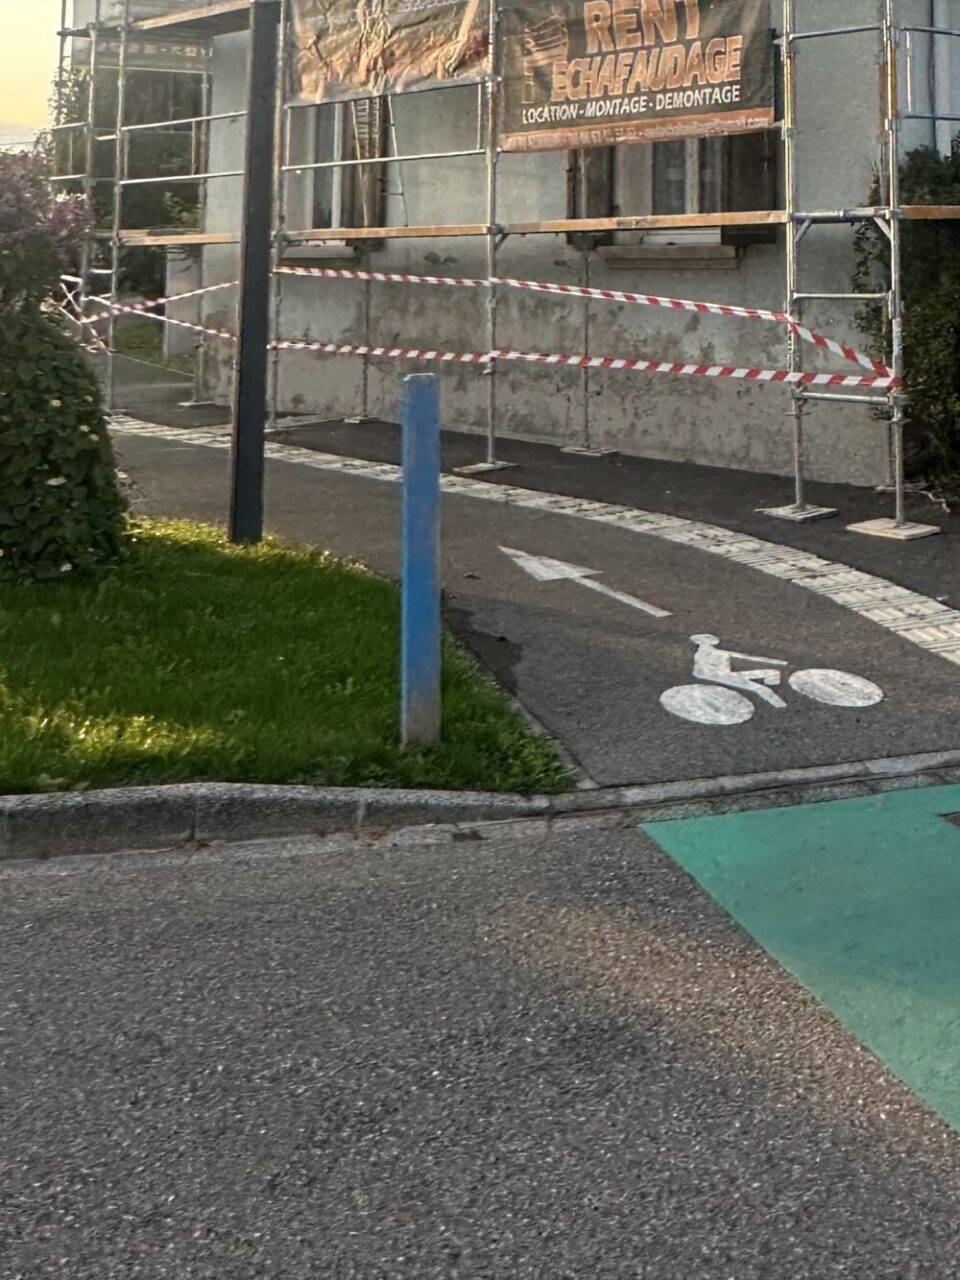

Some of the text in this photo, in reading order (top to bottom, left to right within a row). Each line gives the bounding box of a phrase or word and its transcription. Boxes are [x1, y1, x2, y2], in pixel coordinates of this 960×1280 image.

[551, 35, 743, 102] ECHAFAUDAGE
[522, 104, 577, 125] LOCATION
[584, 97, 648, 118] MONTAGE
